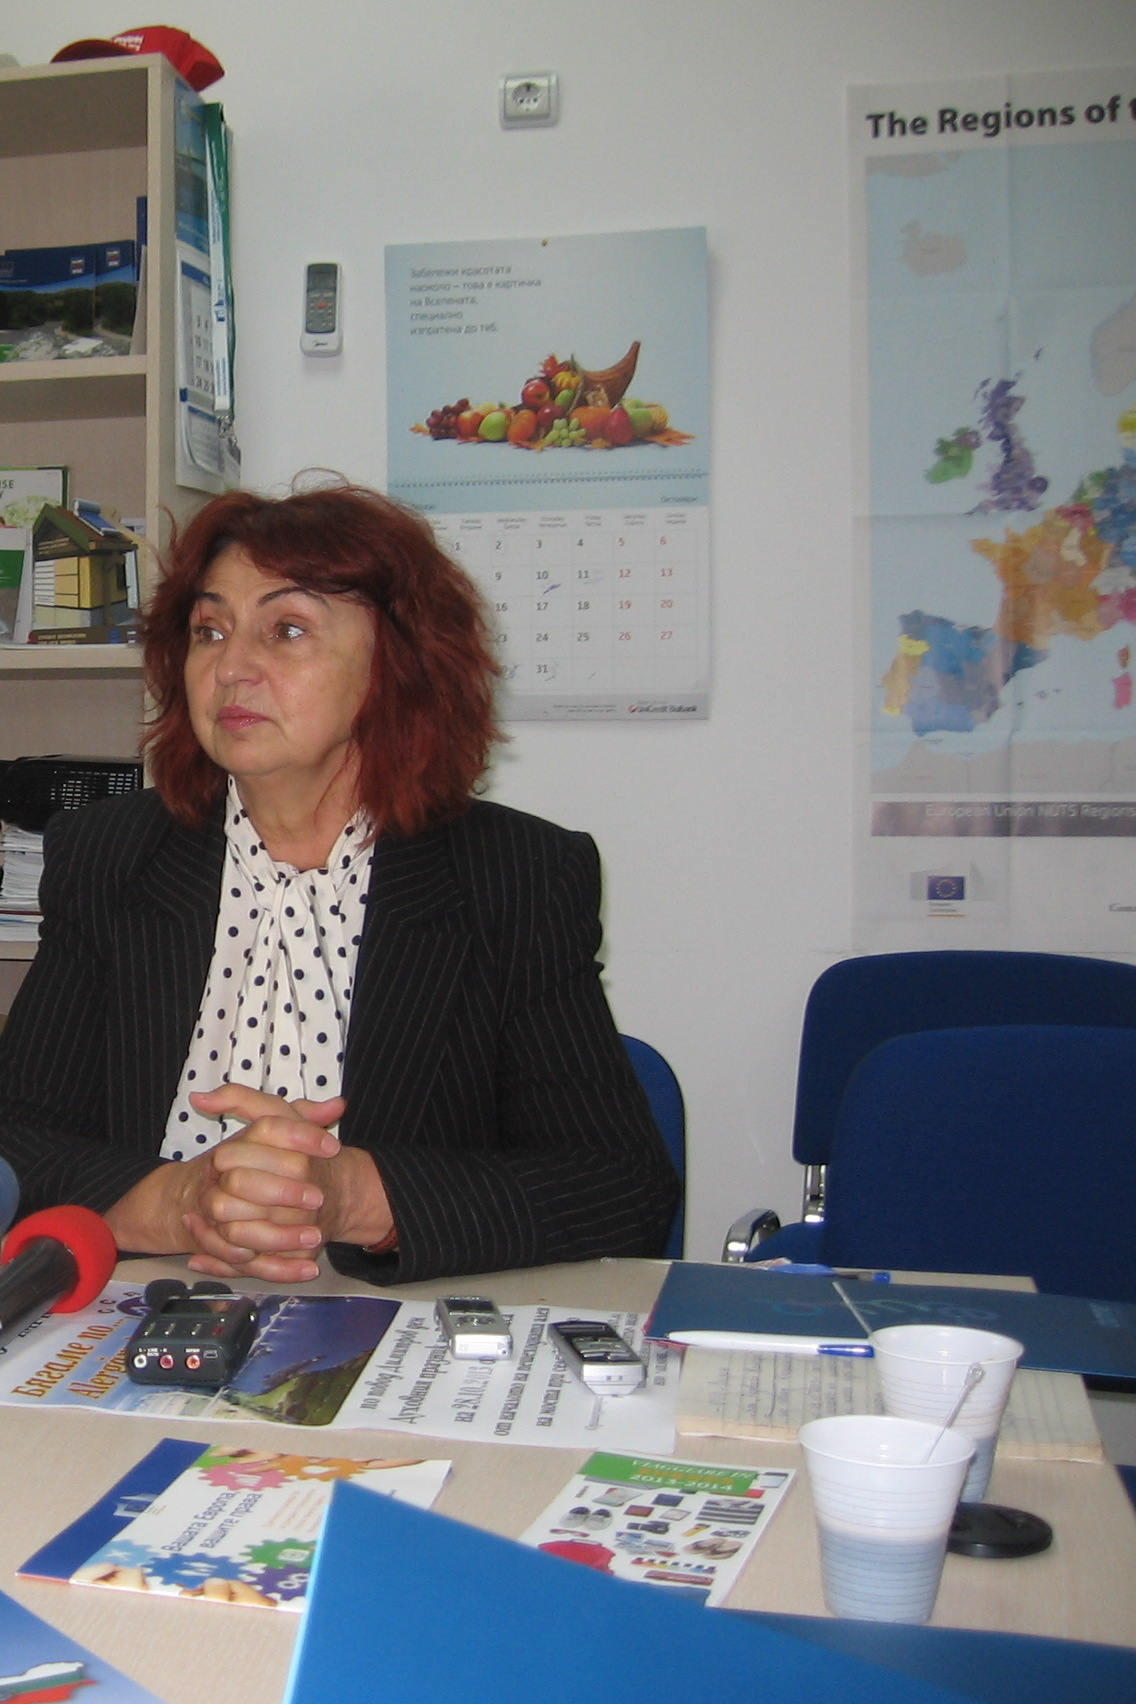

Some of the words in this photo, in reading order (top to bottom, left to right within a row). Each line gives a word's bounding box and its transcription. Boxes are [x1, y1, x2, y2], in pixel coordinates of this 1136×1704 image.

[866, 111, 928, 138] The
[938, 102, 1076, 138] Regions
[1084, 94, 1121, 124] of
[461, 264, 512, 278] красотата
[410, 282, 451, 293] наоколо
[462, 281, 485, 291] това
[495, 278, 542, 291] картинка
[410, 298, 423, 307] на
[410, 311, 463, 323] специално
[410, 325, 462, 337] изпратена
[464, 325, 478, 335] до
[576, 538, 584, 547] 4
[536, 571, 549, 580] 10
[577, 570, 589, 579] 11
[619, 569, 631, 578] 12
[660, 568, 673, 577] 13
[495, 603, 508, 612] 16
[536, 602, 548, 611] 17
[577, 601, 590, 610] 18
[619, 600, 632, 609] 19
[660, 599, 673, 608] 20
[536, 633, 549, 642] 24
[577, 632, 590, 641] 25
[618, 631, 632, 641] 26
[660, 631, 673, 640] 27
[925, 803, 990, 819] European
[994, 803, 1035, 817] Union
[406, 1317, 430, 1331] ден
[376, 1328, 420, 1374] Димитров
[11, 1340, 93, 1398] Бягаме
[514, 1371, 530, 1381] на
[367, 1373, 401, 1398] повод
[547, 1373, 573, 1387] при
[452, 1365, 497, 1410] 28.10.2013
[389, 1380, 433, 1423] Духовния
[499, 1382, 528, 1420] началото
[540, 1388, 562, 1414] моста
[455, 1411, 475, 1422] на
[536, 1416, 554, 1427] на
[494, 1421, 512, 1435] от
[200, 1520, 240, 1548] вашите
[229, 1492, 264, 1516] права
[161, 1521, 208, 1551] Вашата
